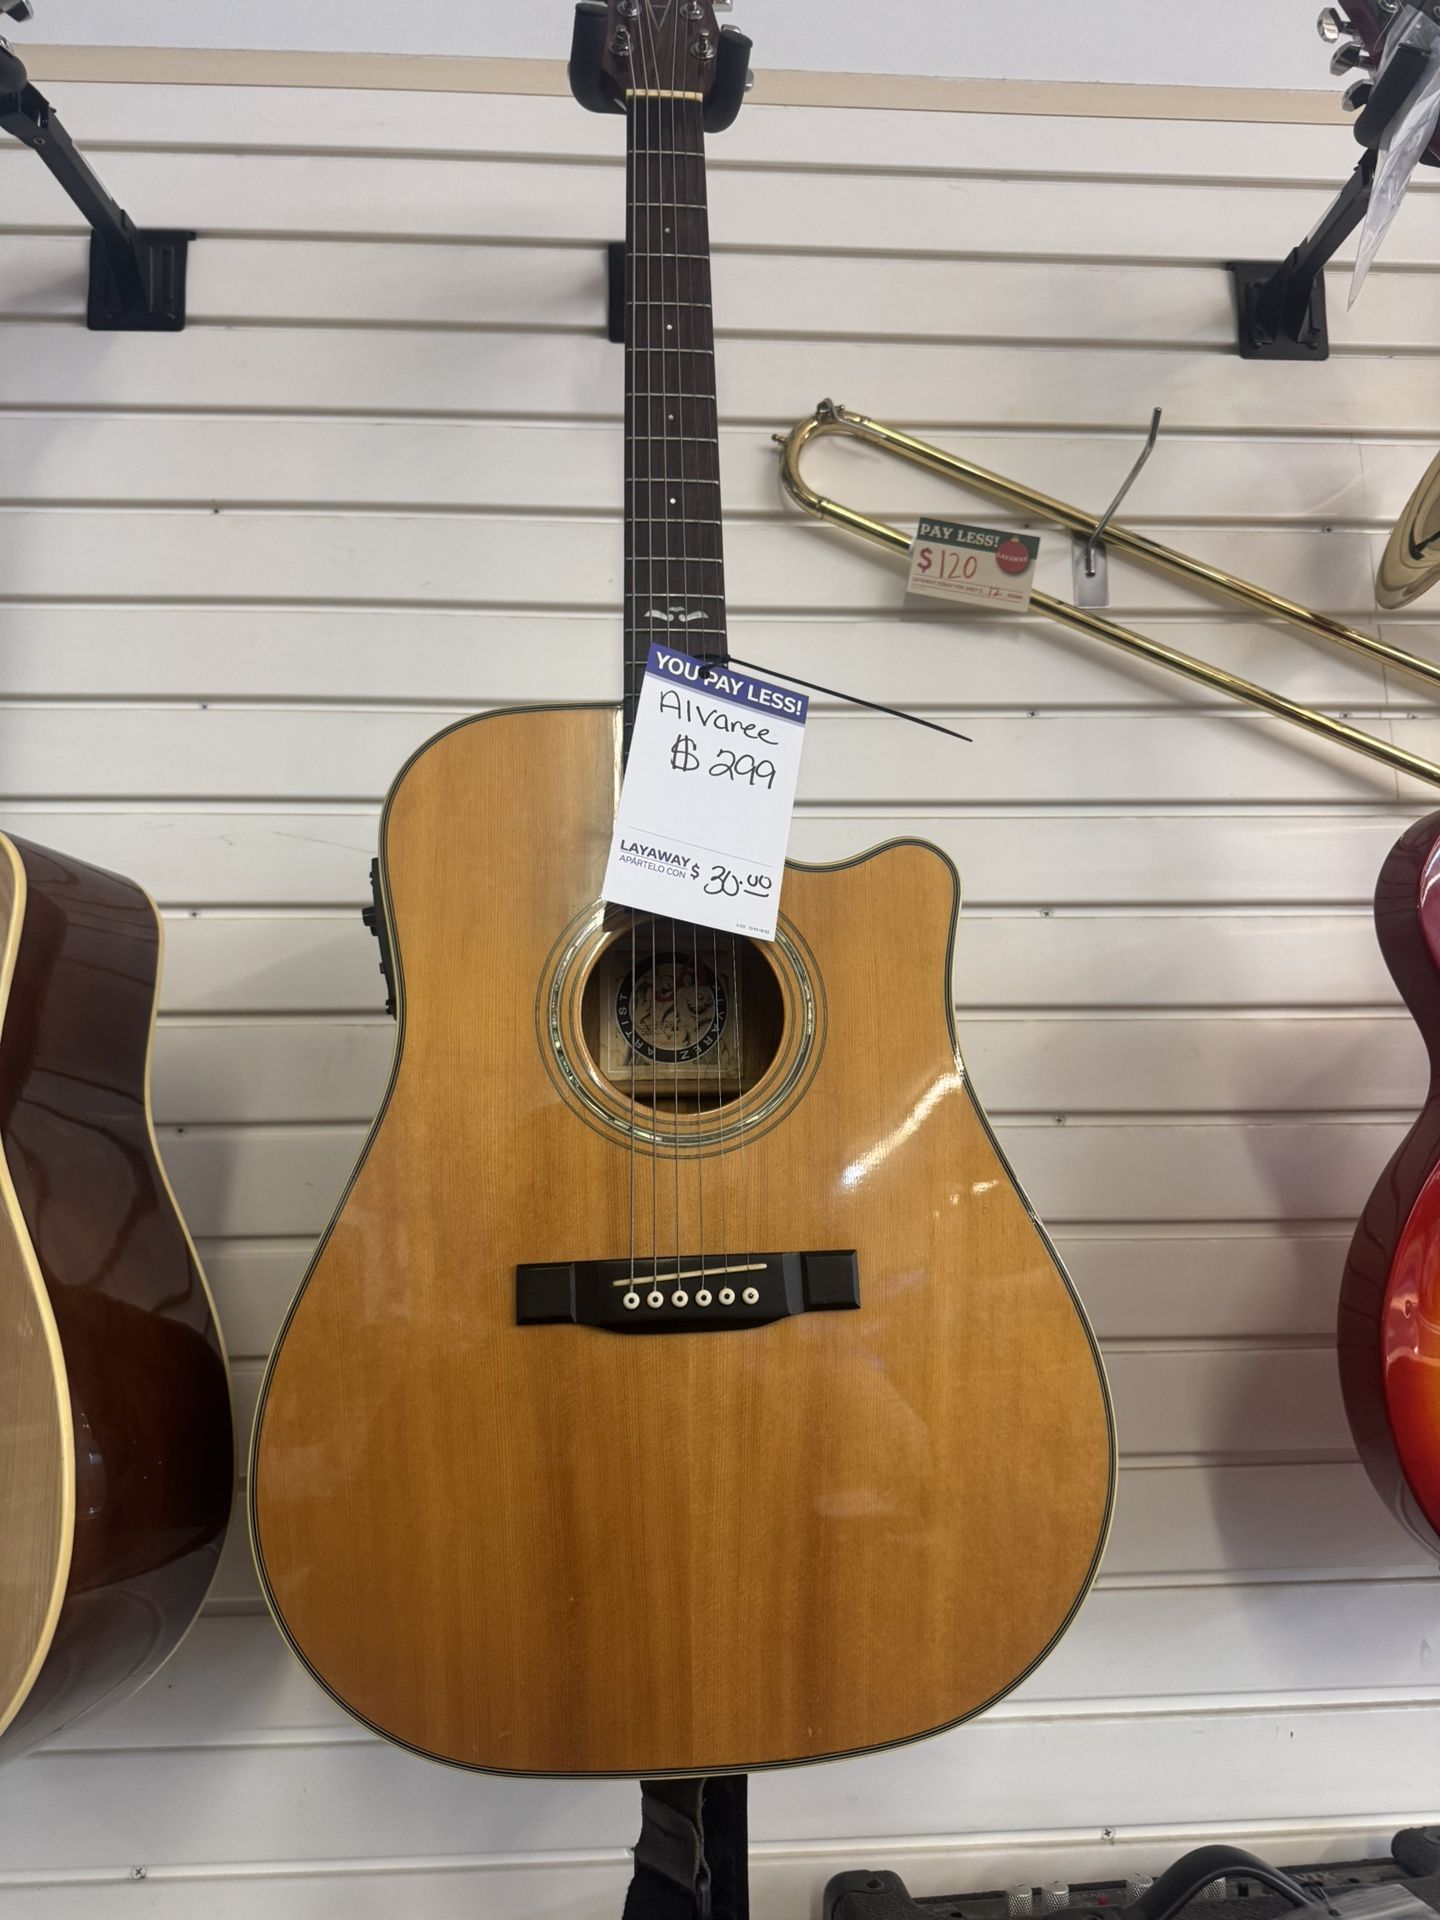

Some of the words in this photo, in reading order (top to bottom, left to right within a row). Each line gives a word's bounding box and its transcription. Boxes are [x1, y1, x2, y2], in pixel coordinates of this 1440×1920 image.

[920, 523, 953, 540] PAY
[957, 530, 1000, 548] LESS!
[656, 651, 700, 681] YOU
[703, 670, 744, 696] PAY
[747, 685, 803, 715] LESS!
[619, 854, 665, 873] APÁRTELO
[667, 867, 687, 879] CON
[620, 839, 691, 868] LAYAWAY
